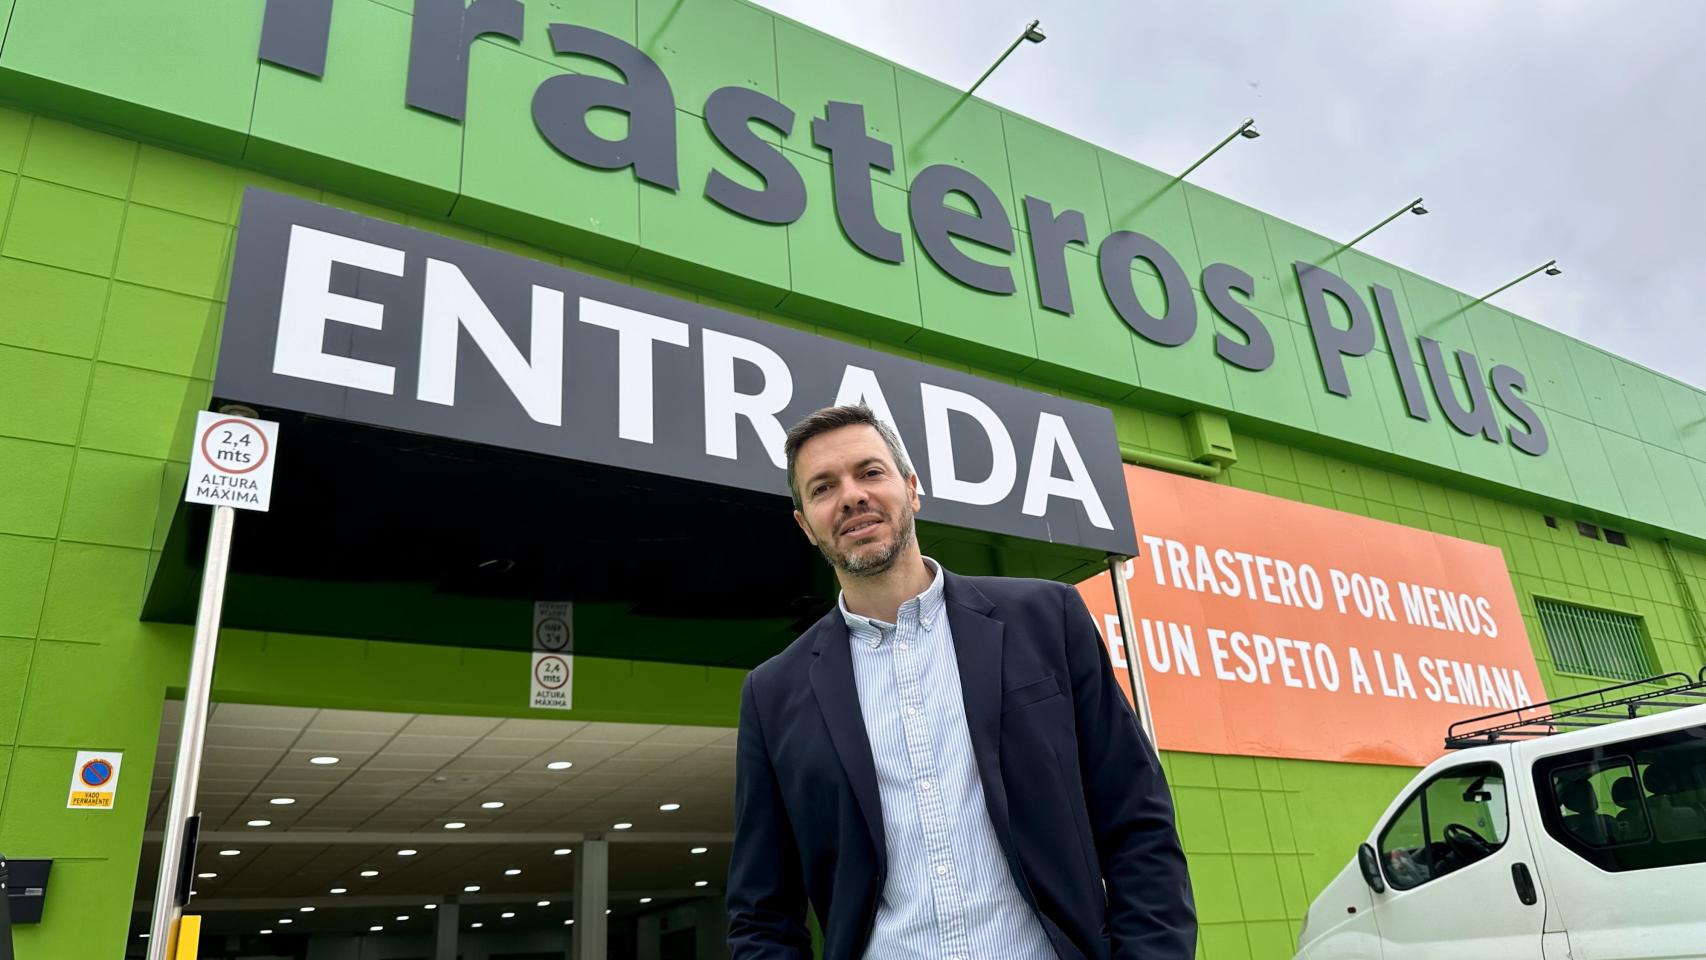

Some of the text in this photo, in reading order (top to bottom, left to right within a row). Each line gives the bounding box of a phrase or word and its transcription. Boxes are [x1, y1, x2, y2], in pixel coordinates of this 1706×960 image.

[1293, 260, 1549, 457] Plus
[222, 431, 251, 447] 2,4
[217, 450, 251, 463] mts
[201, 474, 258, 490] ALTURA
[197, 486, 259, 504] MÁXIMA
[1142, 534, 1324, 610] TRASTERO
[1329, 569, 1397, 622] POR
[1398, 582, 1499, 639] MENOS
[545, 663, 560, 673] 2,4
[1090, 613, 1537, 712] E UN ESPETO A LA SEMANA
[543, 675, 561, 683] mts
